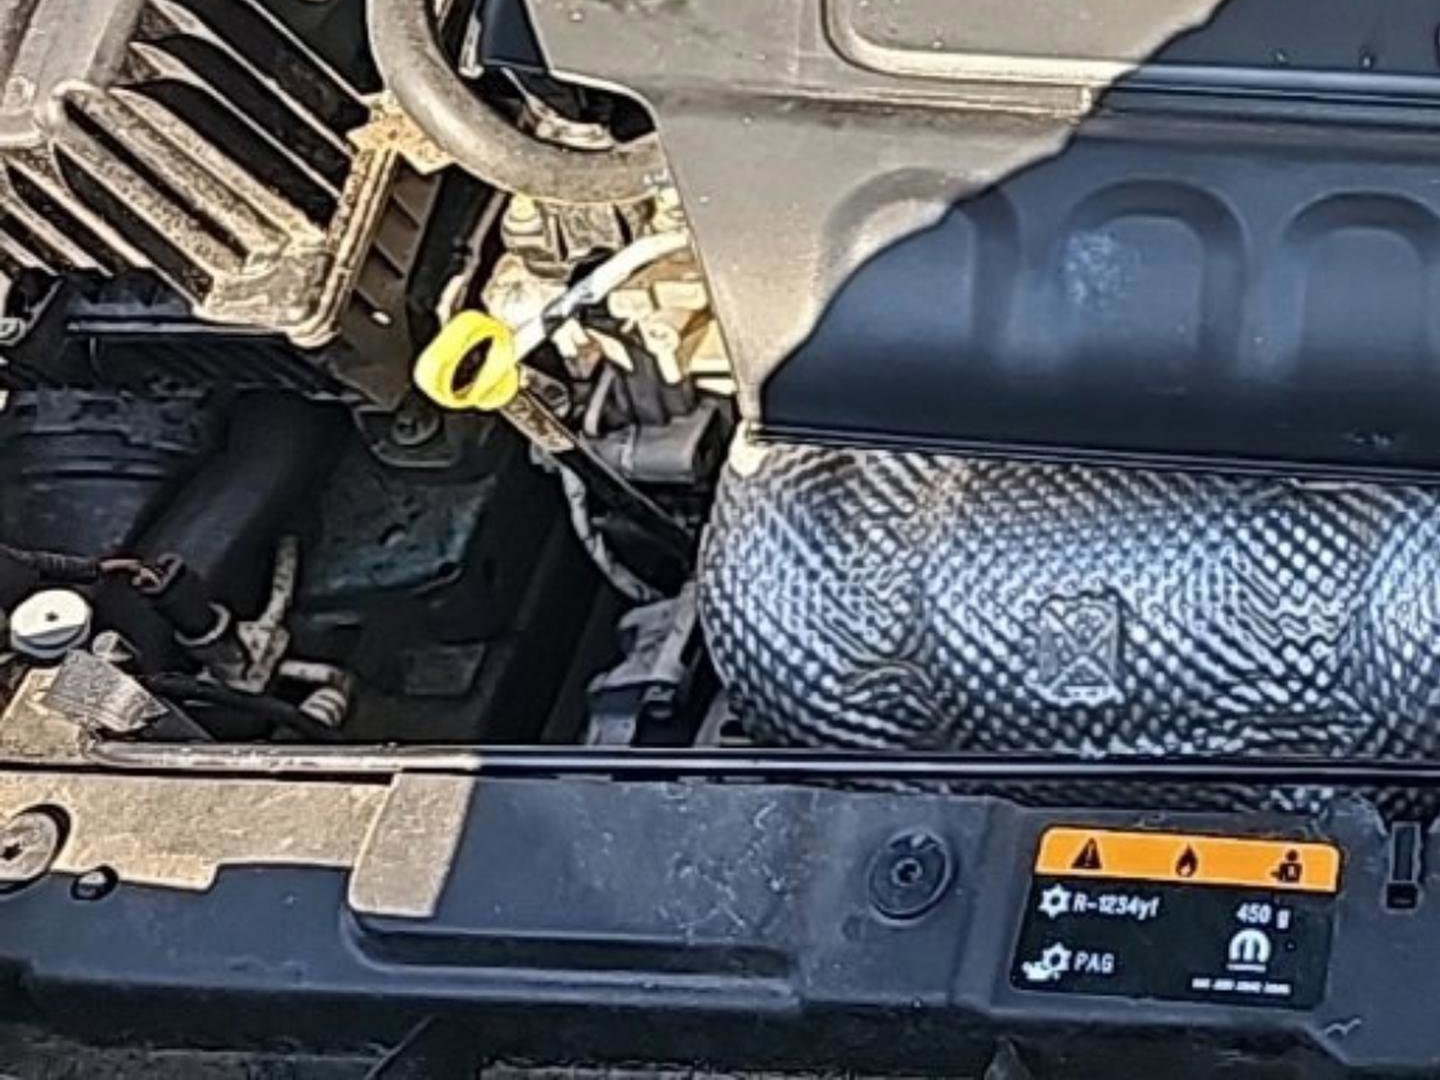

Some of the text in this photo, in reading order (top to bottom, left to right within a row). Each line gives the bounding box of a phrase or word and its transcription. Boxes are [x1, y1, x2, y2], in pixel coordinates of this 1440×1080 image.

[1073, 890, 1160, 921] R-1234yf
[1236, 902, 1272, 925] 450
[1073, 951, 1115, 974] PAG
